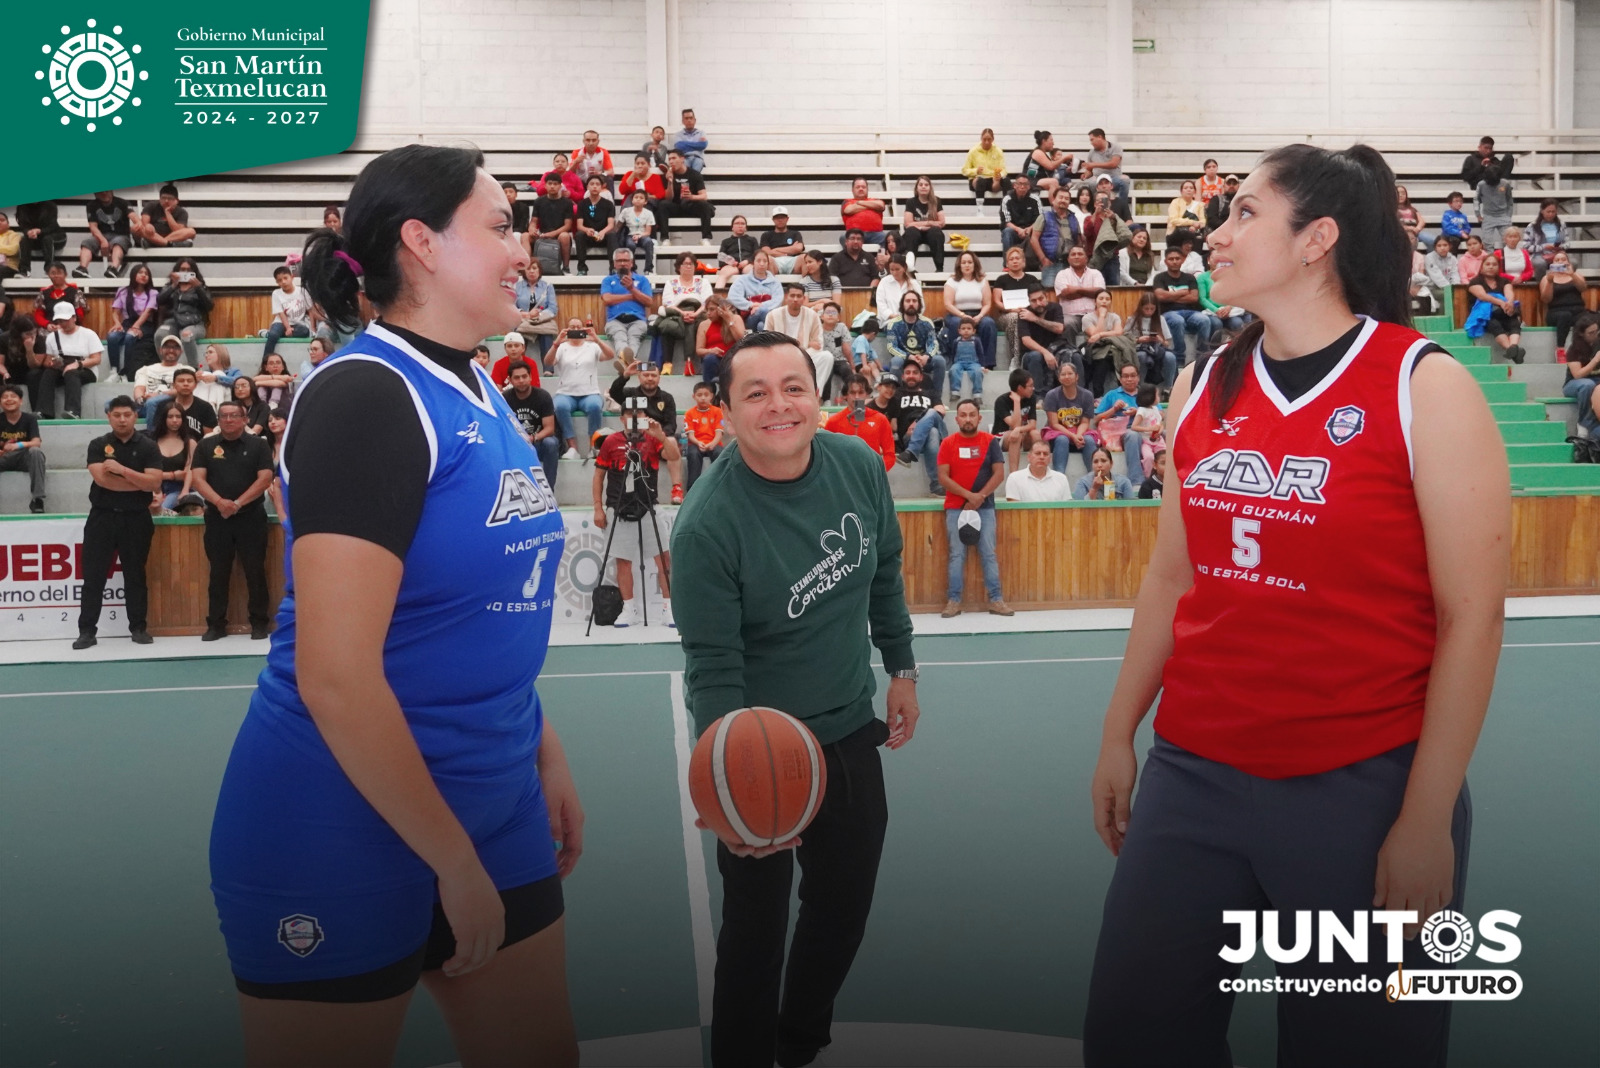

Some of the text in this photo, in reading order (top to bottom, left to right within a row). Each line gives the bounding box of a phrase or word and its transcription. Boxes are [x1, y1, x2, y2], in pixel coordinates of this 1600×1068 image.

[900, 395, 931, 408] GAP
[1183, 449, 1330, 504] ADR
[1188, 497, 1316, 525] NAOMI GUZMÁN
[504, 535, 541, 555] NAOMI
[1232, 516, 1261, 569] 5
[788, 564, 859, 618] Corazón
[1198, 563, 1306, 592] NO ESTÁS SOLA
[40, 585, 67, 602] del
